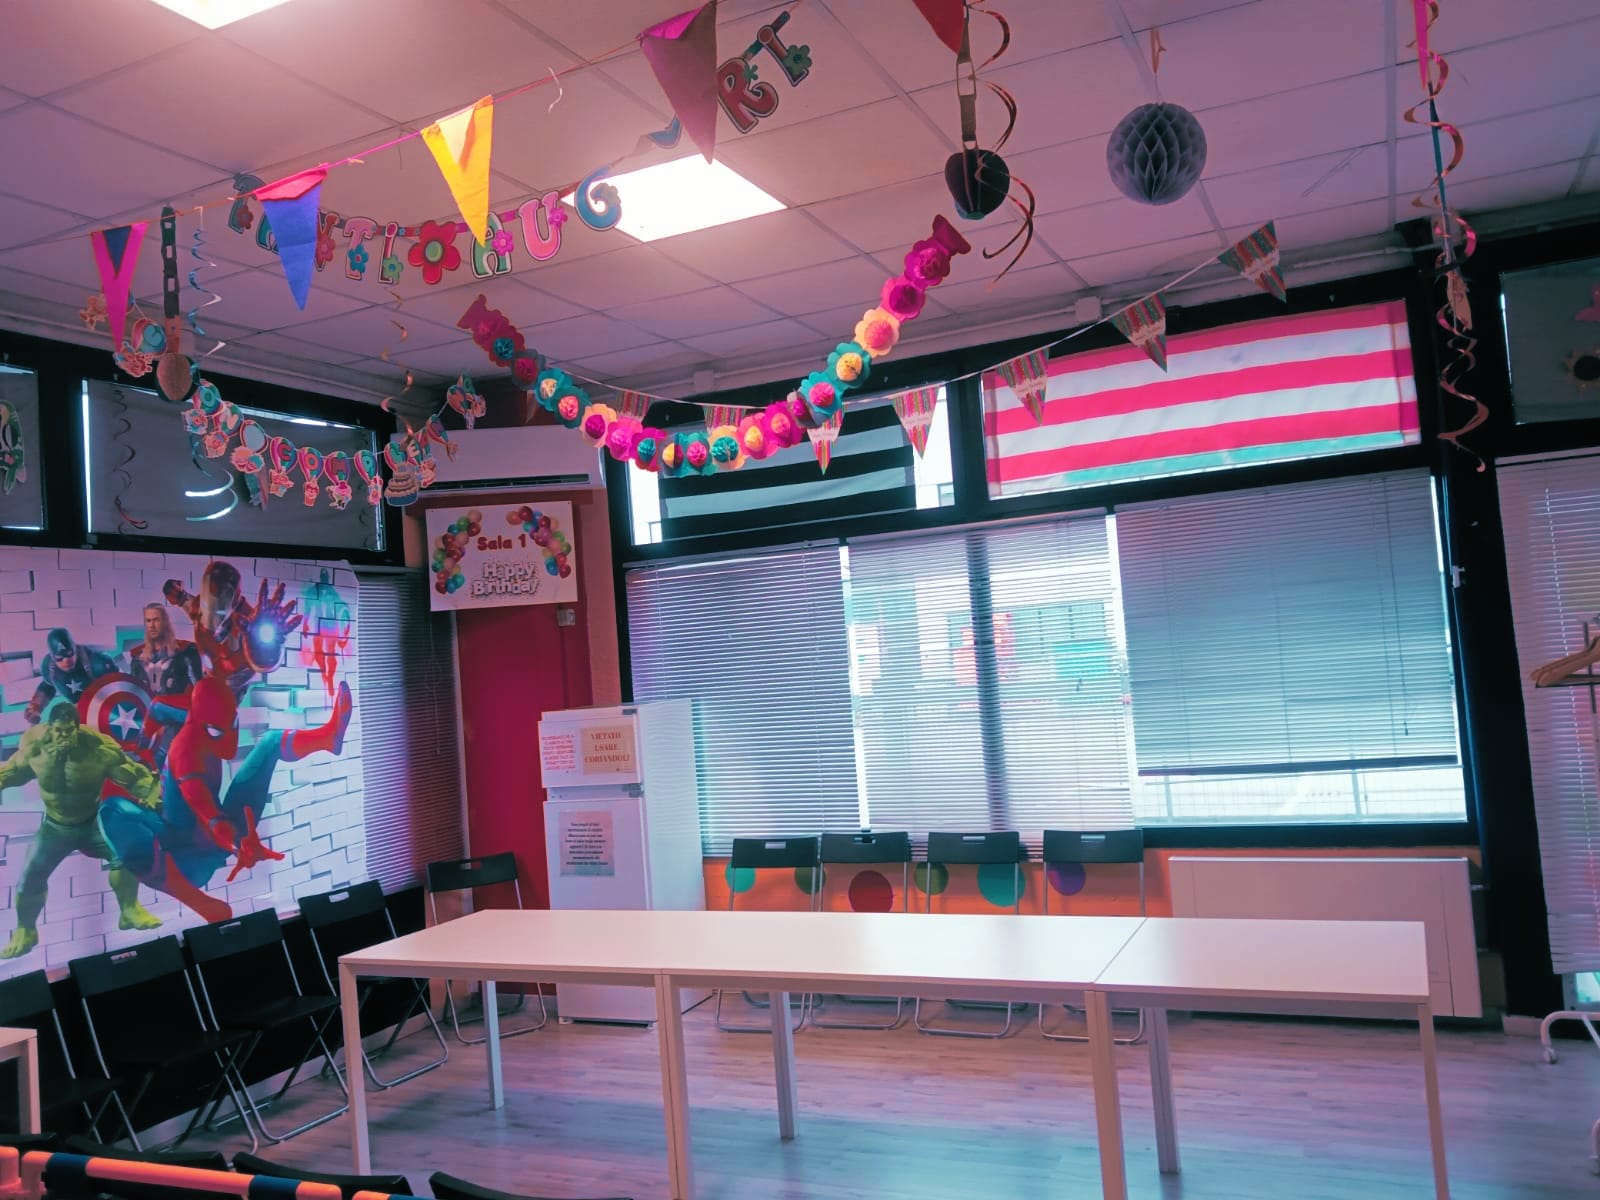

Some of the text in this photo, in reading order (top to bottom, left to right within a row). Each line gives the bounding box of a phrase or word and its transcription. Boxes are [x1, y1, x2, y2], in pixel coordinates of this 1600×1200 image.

[476, 533, 527, 551] Sala 1
[482, 561, 537, 580] Happy
[472, 577, 540, 597] Birthday
[594, 743, 619, 752] USARE
